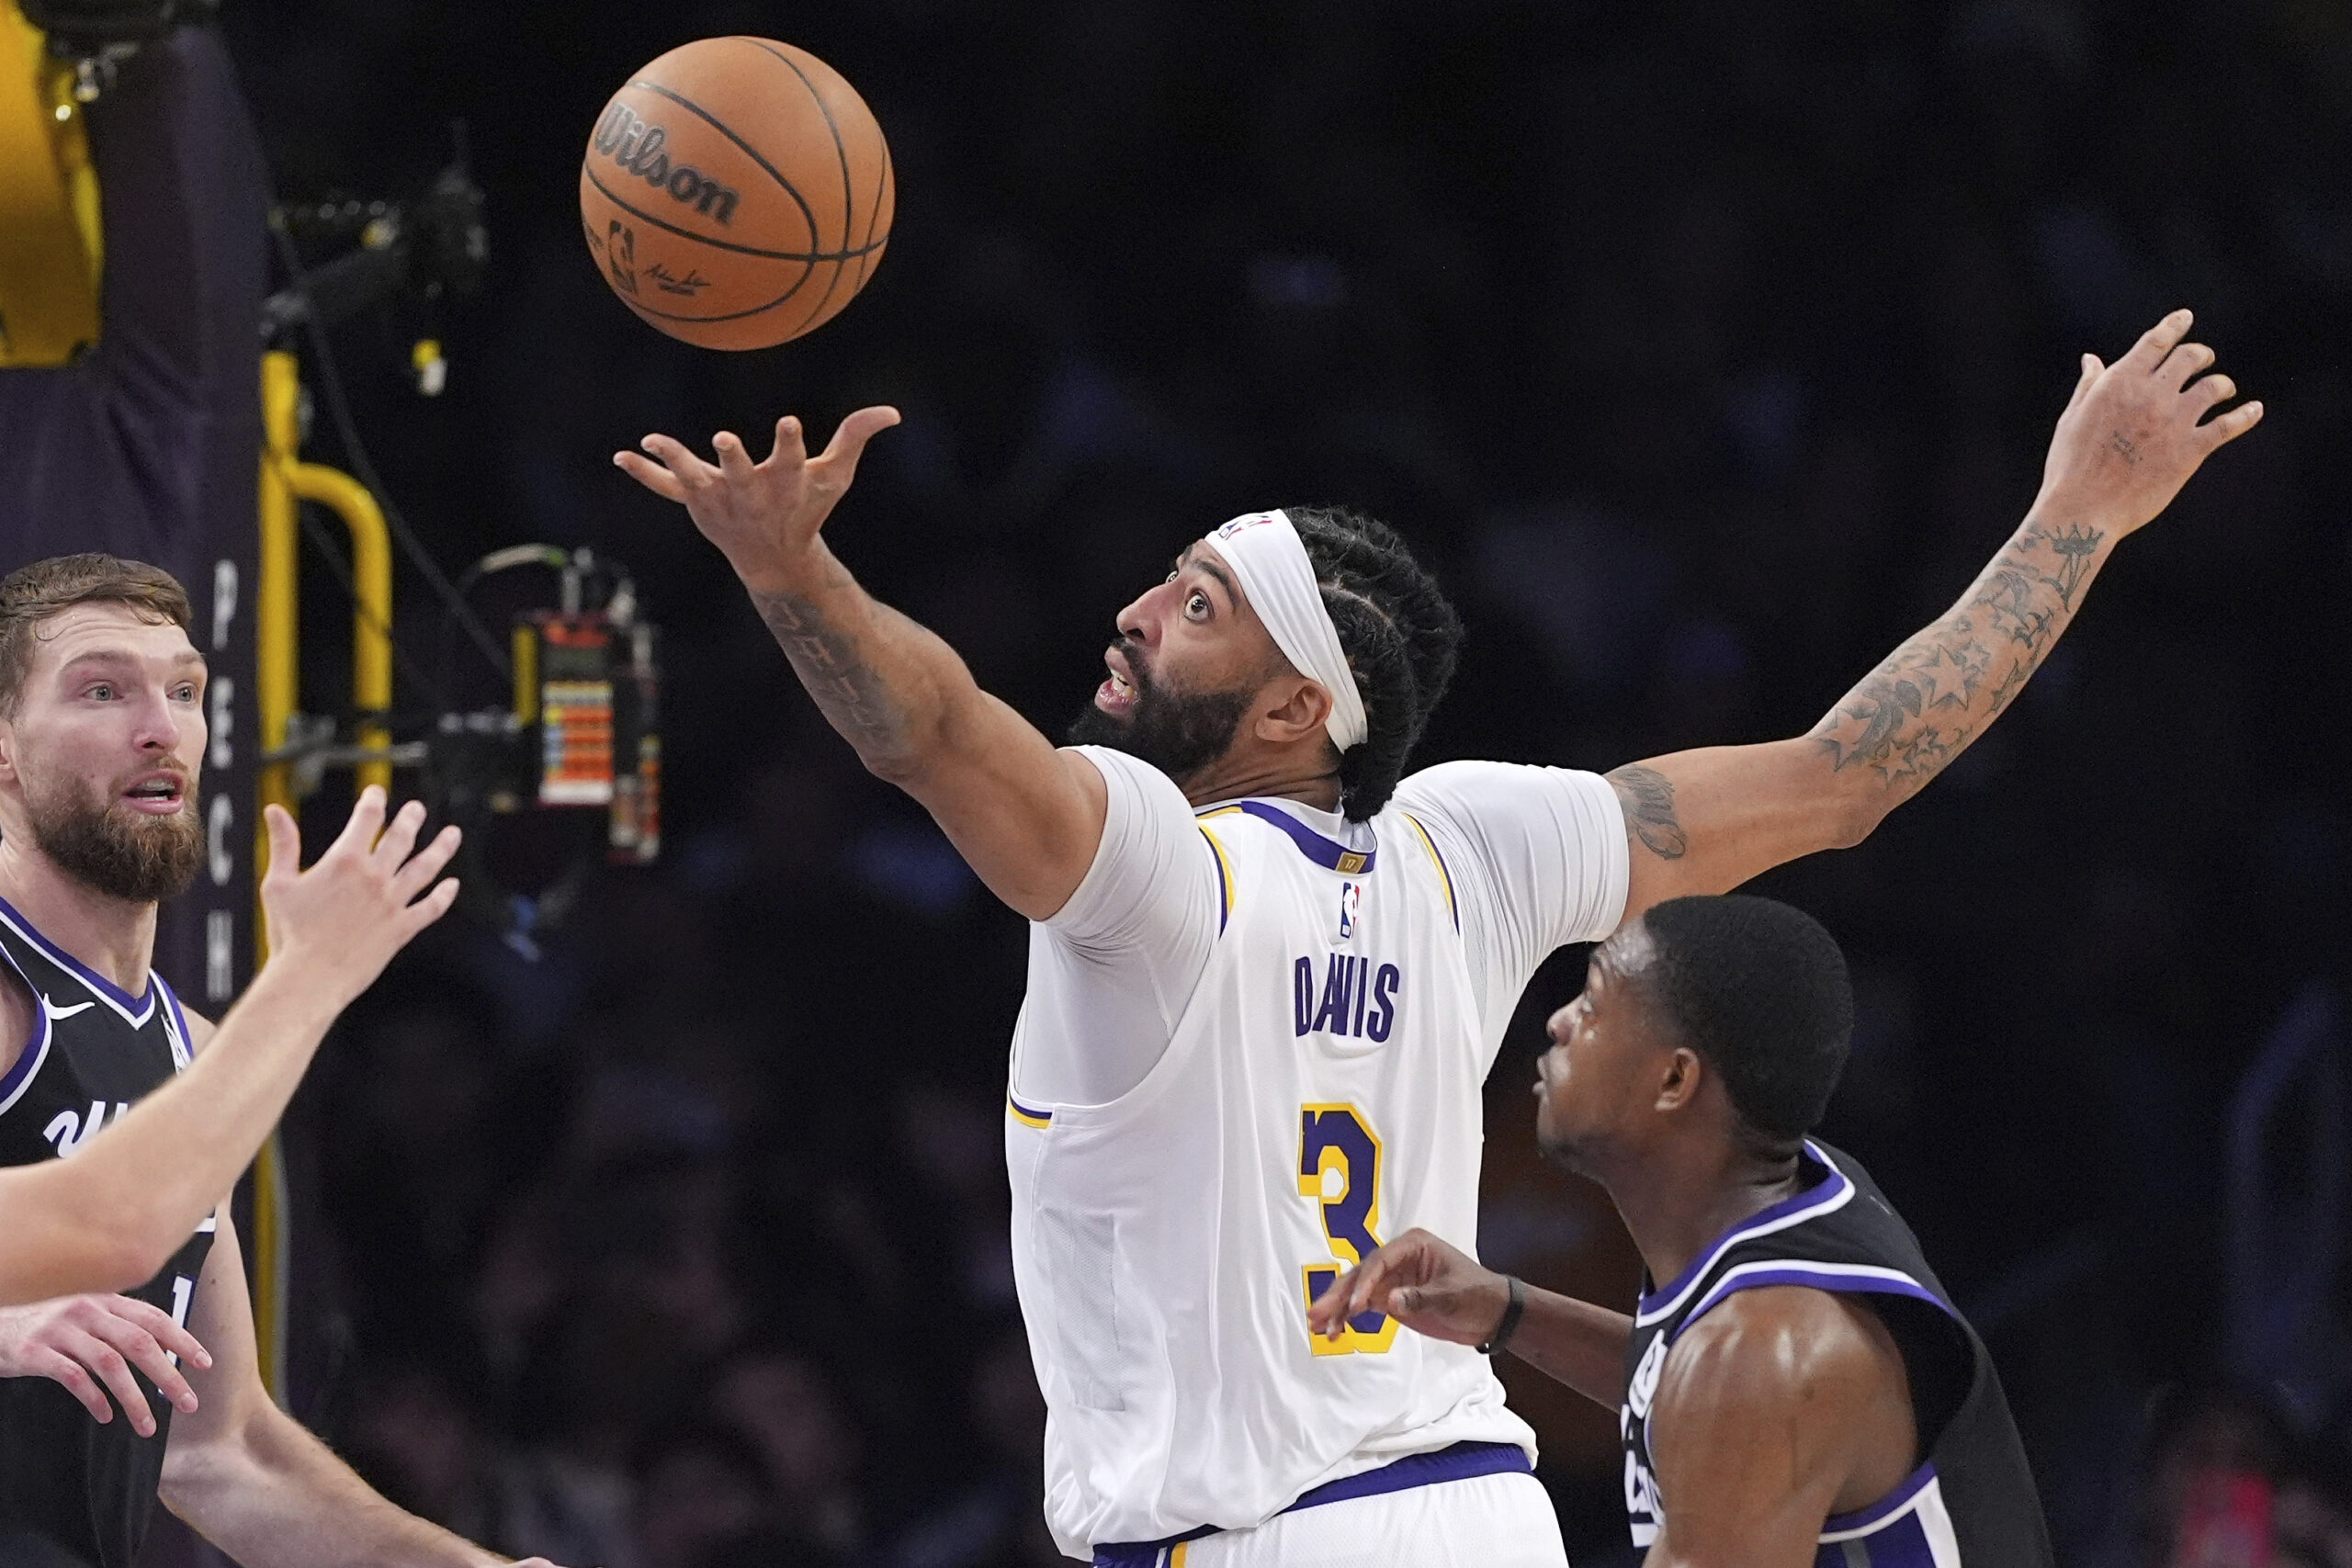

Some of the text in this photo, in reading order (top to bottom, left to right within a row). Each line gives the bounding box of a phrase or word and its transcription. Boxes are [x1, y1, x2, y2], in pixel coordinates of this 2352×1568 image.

[594, 101, 741, 225] Wilson
[1295, 953, 1399, 1043] DAVIS
[1297, 1103, 1400, 1356] 3
